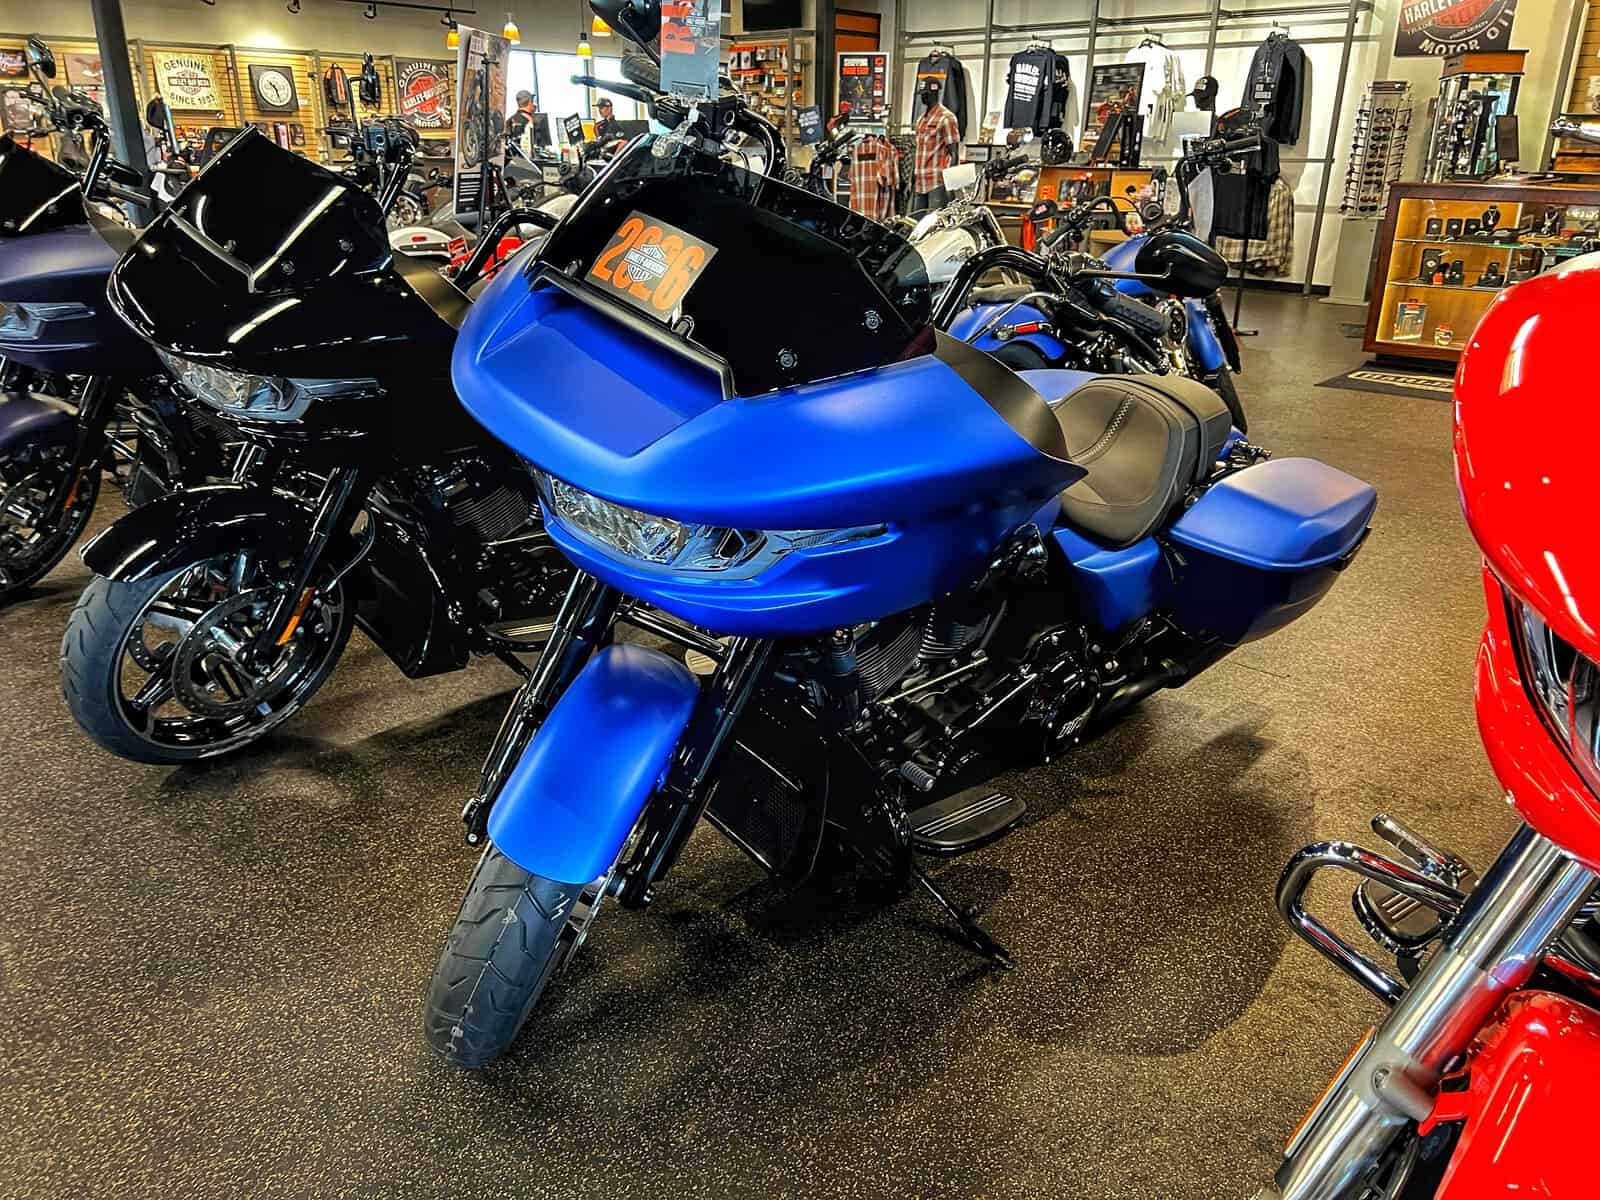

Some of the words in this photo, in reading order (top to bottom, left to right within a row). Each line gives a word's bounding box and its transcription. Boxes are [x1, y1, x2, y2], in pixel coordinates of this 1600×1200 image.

[1419, 38, 1480, 55] MOTOR
[164, 59, 208, 73] GENUINE
[399, 62, 437, 88] GENUINE
[170, 92, 196, 105] SINCE
[592, 217, 705, 310] 2026
